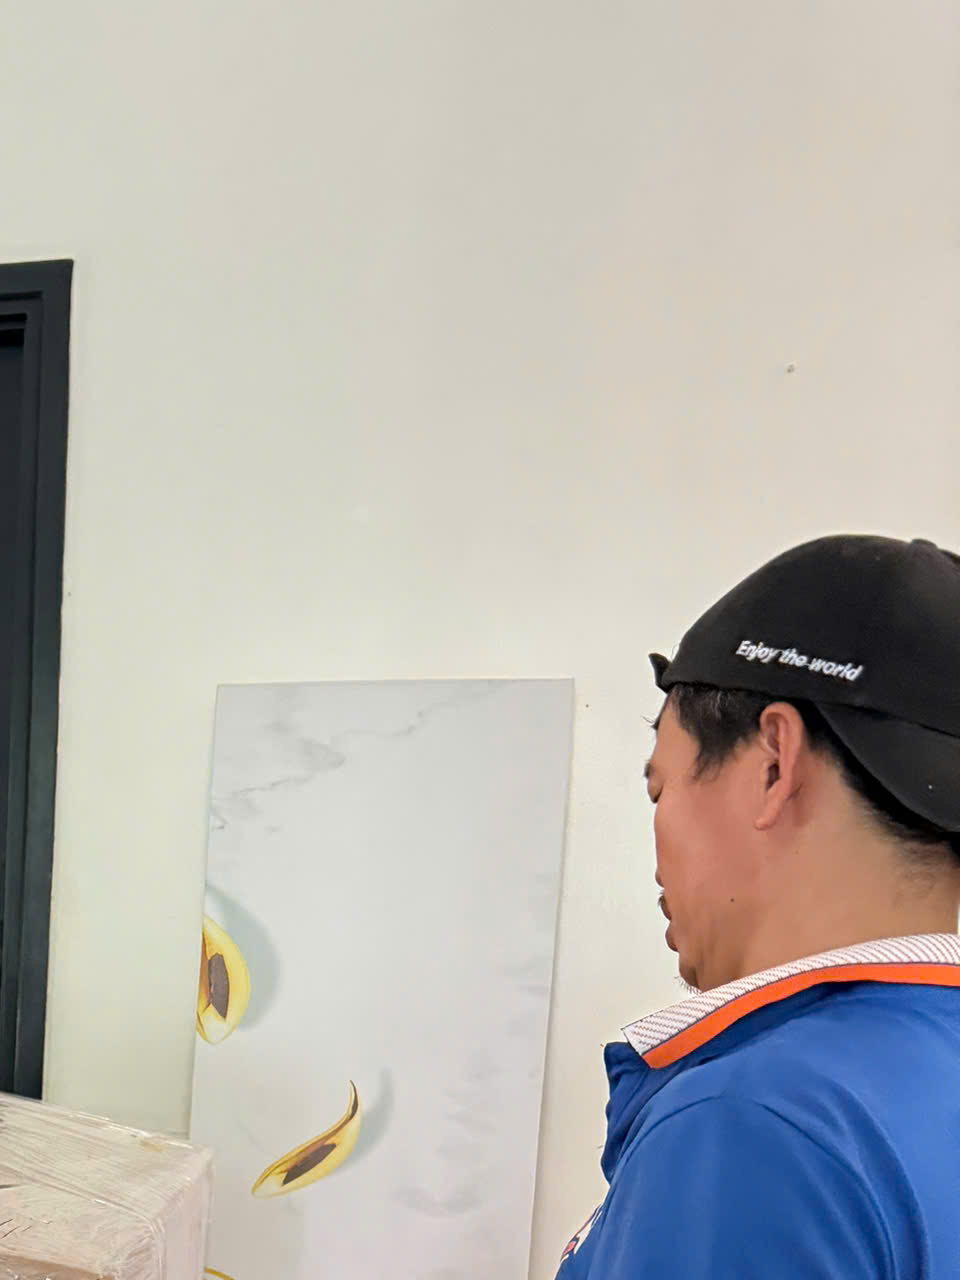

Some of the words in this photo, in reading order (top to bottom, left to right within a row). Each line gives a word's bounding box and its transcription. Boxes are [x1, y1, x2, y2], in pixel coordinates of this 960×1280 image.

[736, 640, 778, 663] Enjoy
[779, 648, 808, 667] the
[808, 657, 863, 681] world
